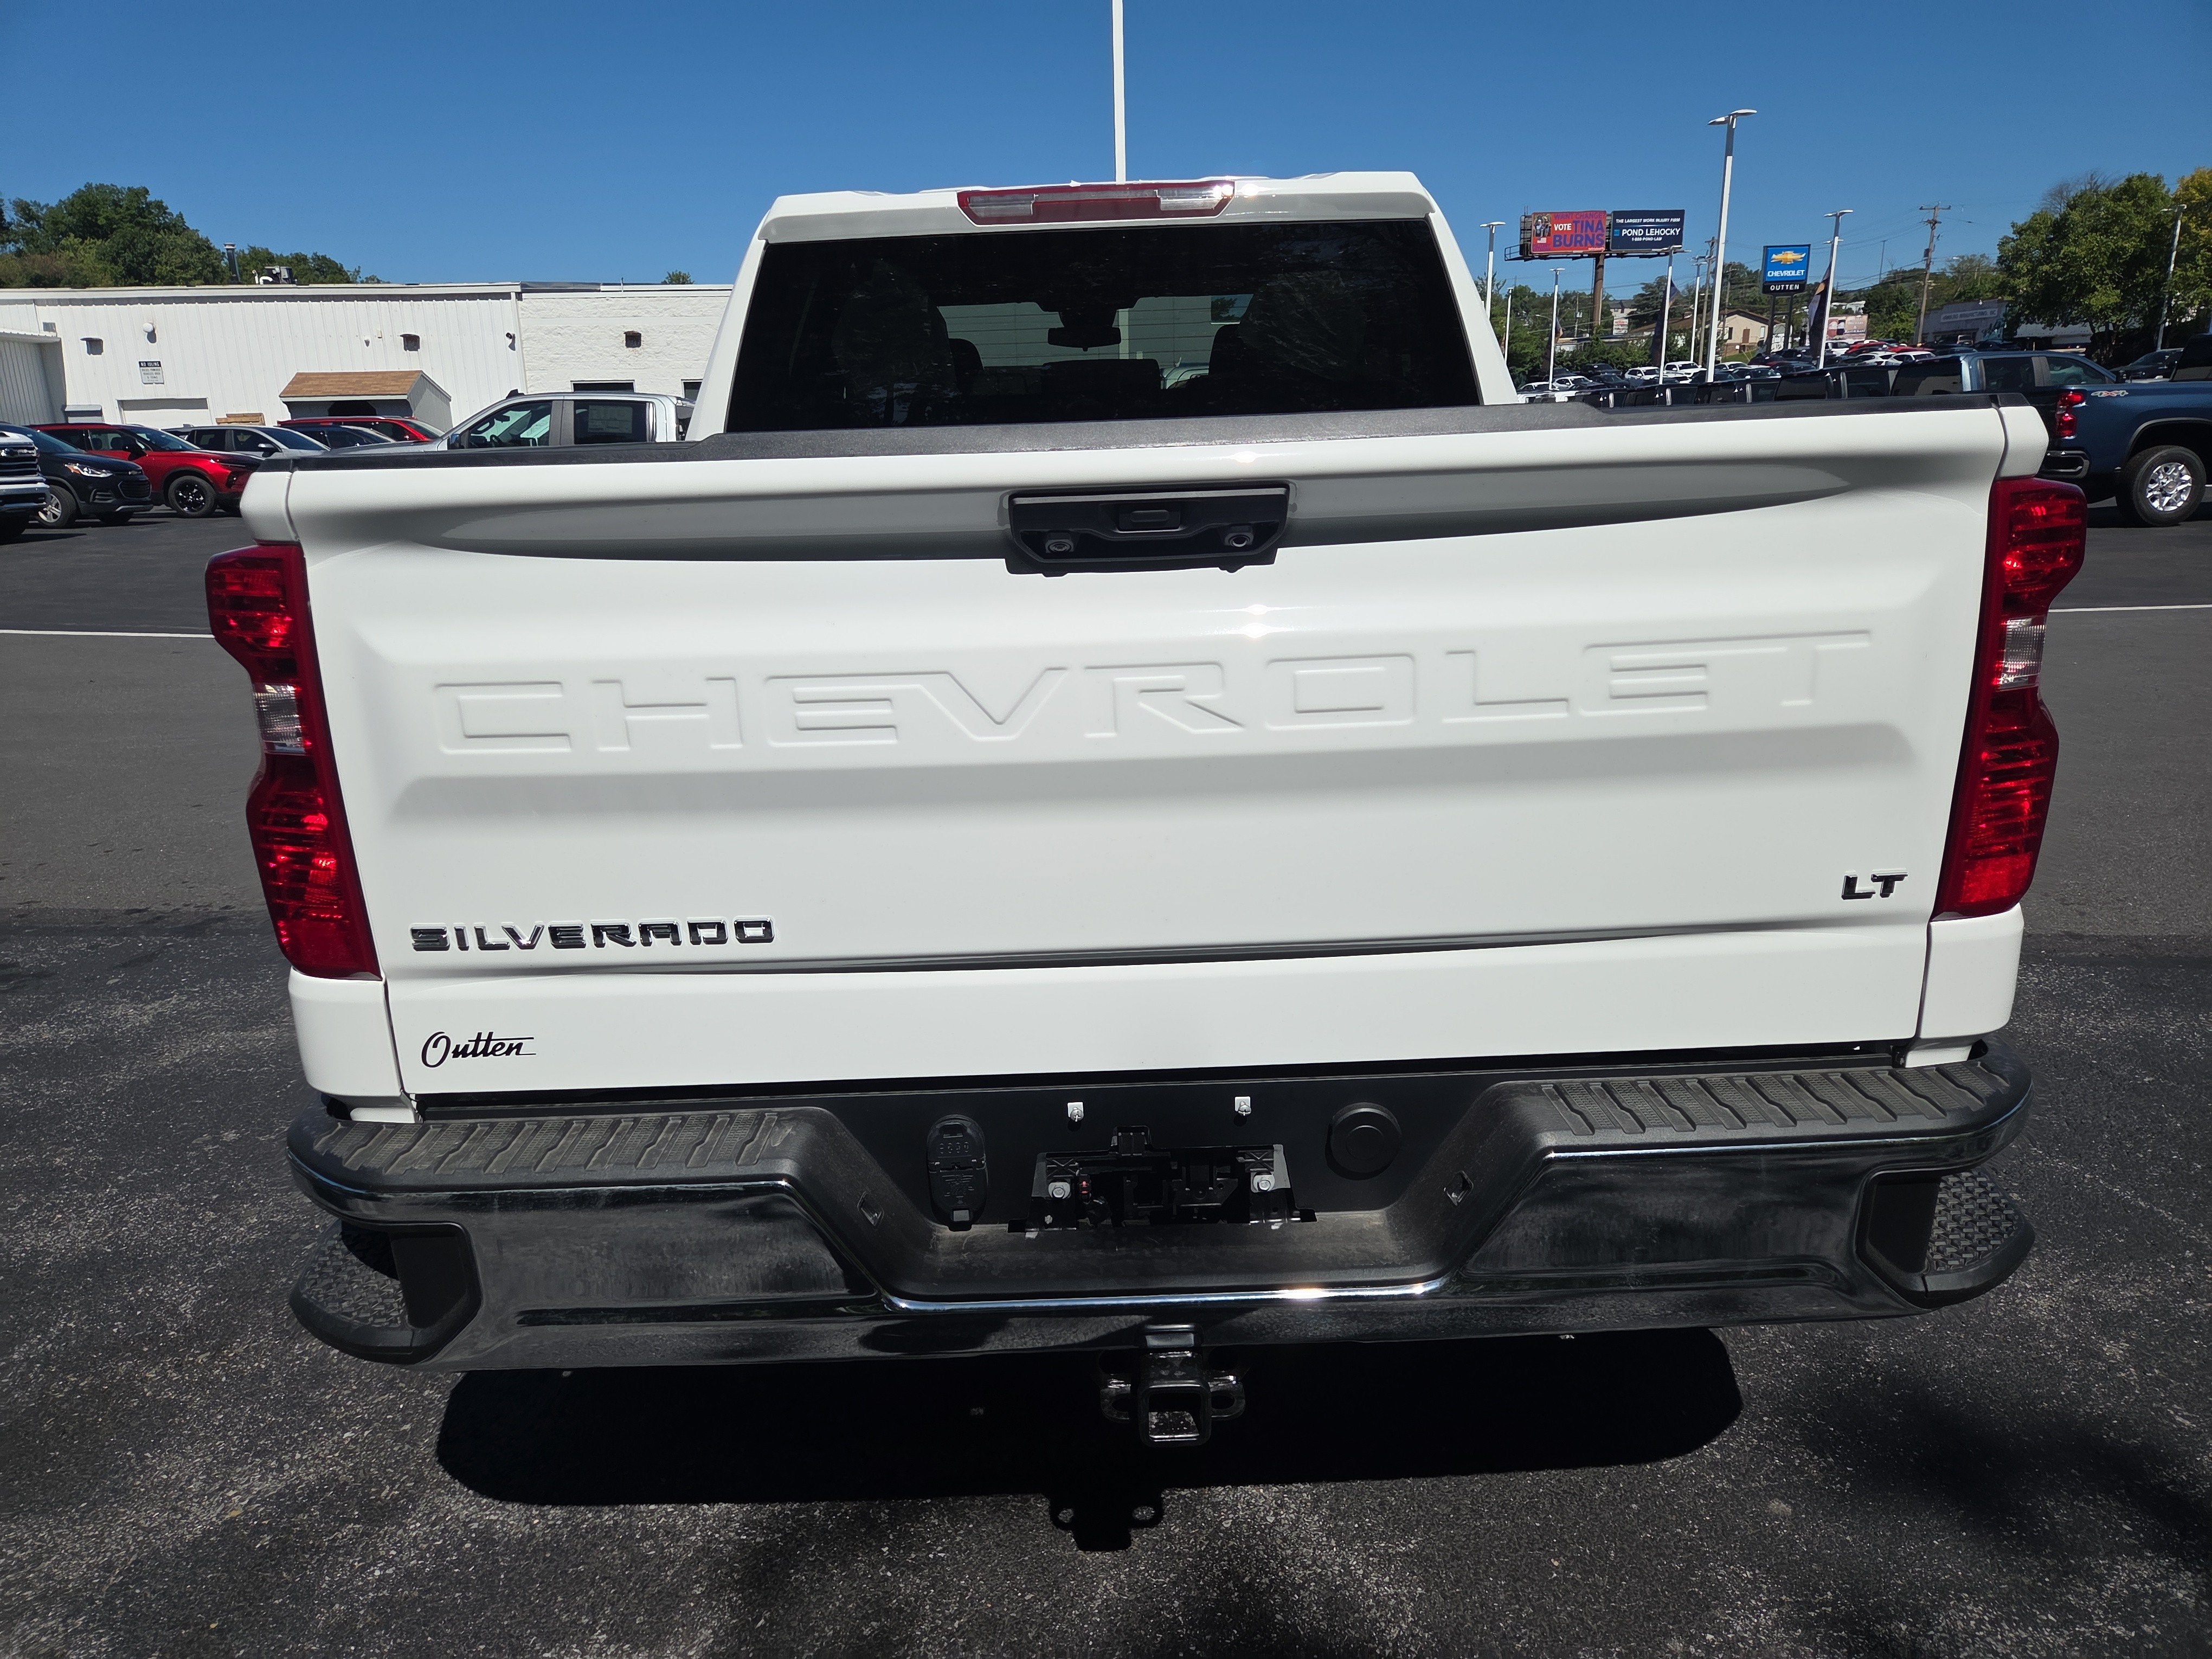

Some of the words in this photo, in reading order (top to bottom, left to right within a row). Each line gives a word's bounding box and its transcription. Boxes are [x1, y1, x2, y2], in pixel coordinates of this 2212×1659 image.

[1553, 234, 1604, 248] BURNS
[1554, 223, 1572, 231] VOTE
[1572, 220, 1604, 234] TINA
[1622, 228, 1644, 236] POND
[1645, 228, 1681, 236] LEHOCKY
[434, 628, 1873, 757] CHEVROLET
[1841, 868, 1908, 900] LT
[409, 916, 776, 951] SILVERADO
[421, 1031, 537, 1068] Outten
